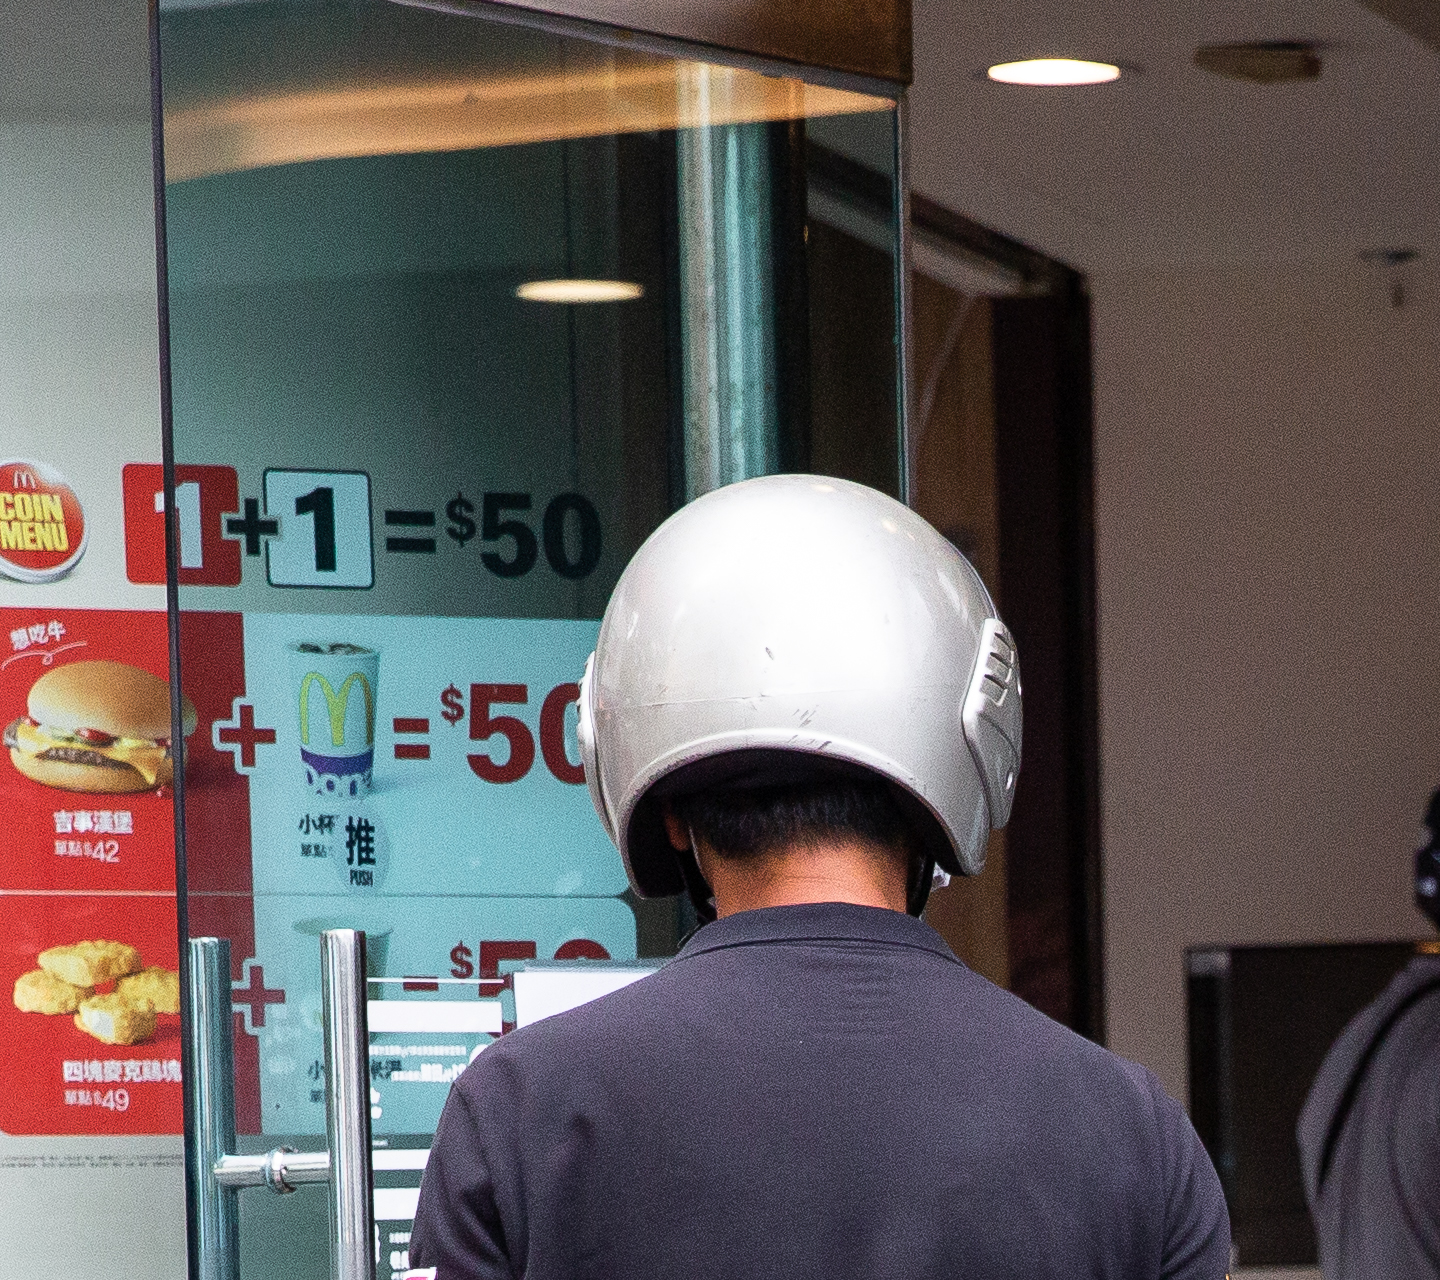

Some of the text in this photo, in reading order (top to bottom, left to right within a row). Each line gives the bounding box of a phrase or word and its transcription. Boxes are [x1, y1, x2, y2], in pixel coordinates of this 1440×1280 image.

[446, 490, 603, 581] $50
[10, 620, 67, 652] 想吃牛
[53, 810, 134, 835] 吉事漢堡
[298, 813, 340, 835] 小杯
[345, 816, 377, 867] 推
[350, 869, 374, 887] PUSH
